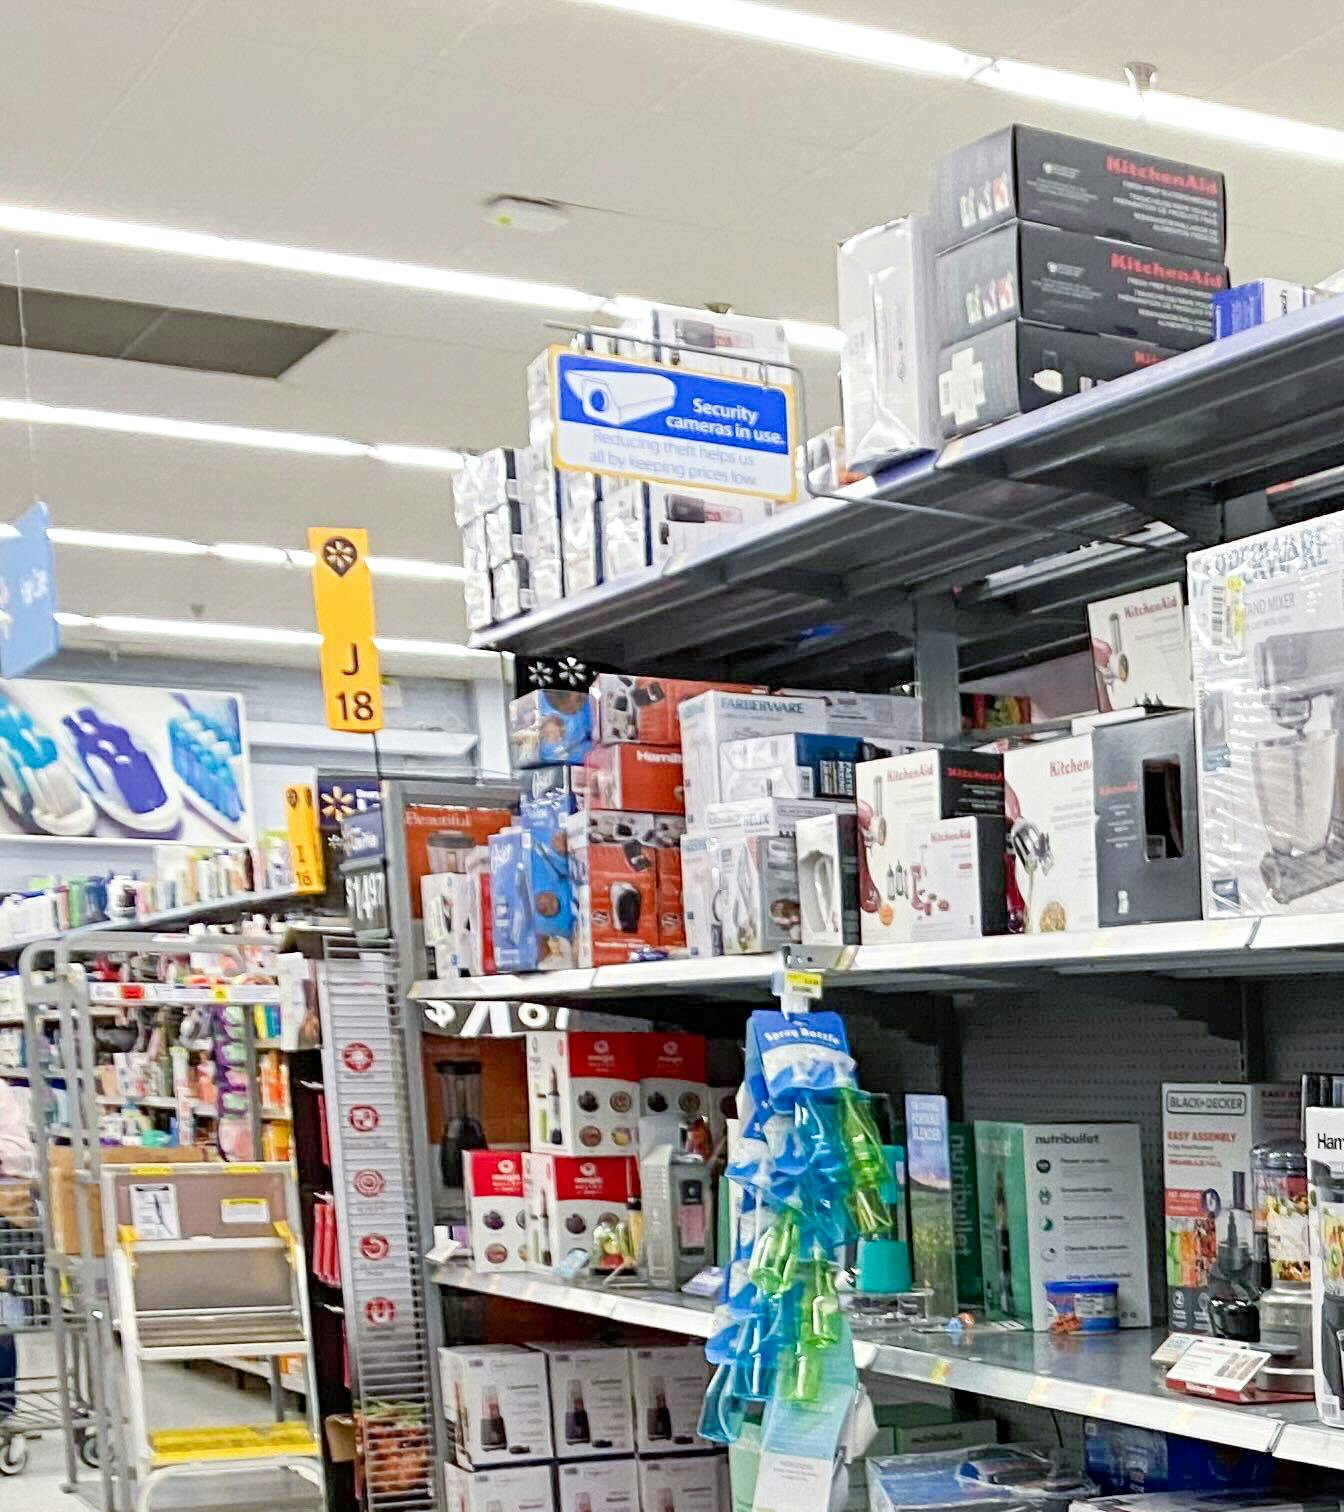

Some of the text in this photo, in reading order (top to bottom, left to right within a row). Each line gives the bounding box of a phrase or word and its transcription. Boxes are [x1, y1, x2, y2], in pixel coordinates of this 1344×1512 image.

[1106, 155, 1218, 196] KitchenAid
[1111, 253, 1223, 289] KitchenAid
[693, 398, 757, 424] Security
[665, 414, 785, 448] cameras in use.
[593, 430, 697, 460] Reducing theft
[1123, 594, 1178, 618] KitchenAid
[342, 643, 358, 676] J
[338, 691, 374, 721] 18
[887, 764, 934, 781] KitchenAid
[405, 811, 471, 828] Beautiful
[931, 829, 971, 843] KitchenAid
[1170, 1097, 1243, 1108] BLACK+DECKER
[1035, 1133, 1099, 1146] nutribullet
[1168, 1131, 1236, 1142] EASY ASSEMBLY
